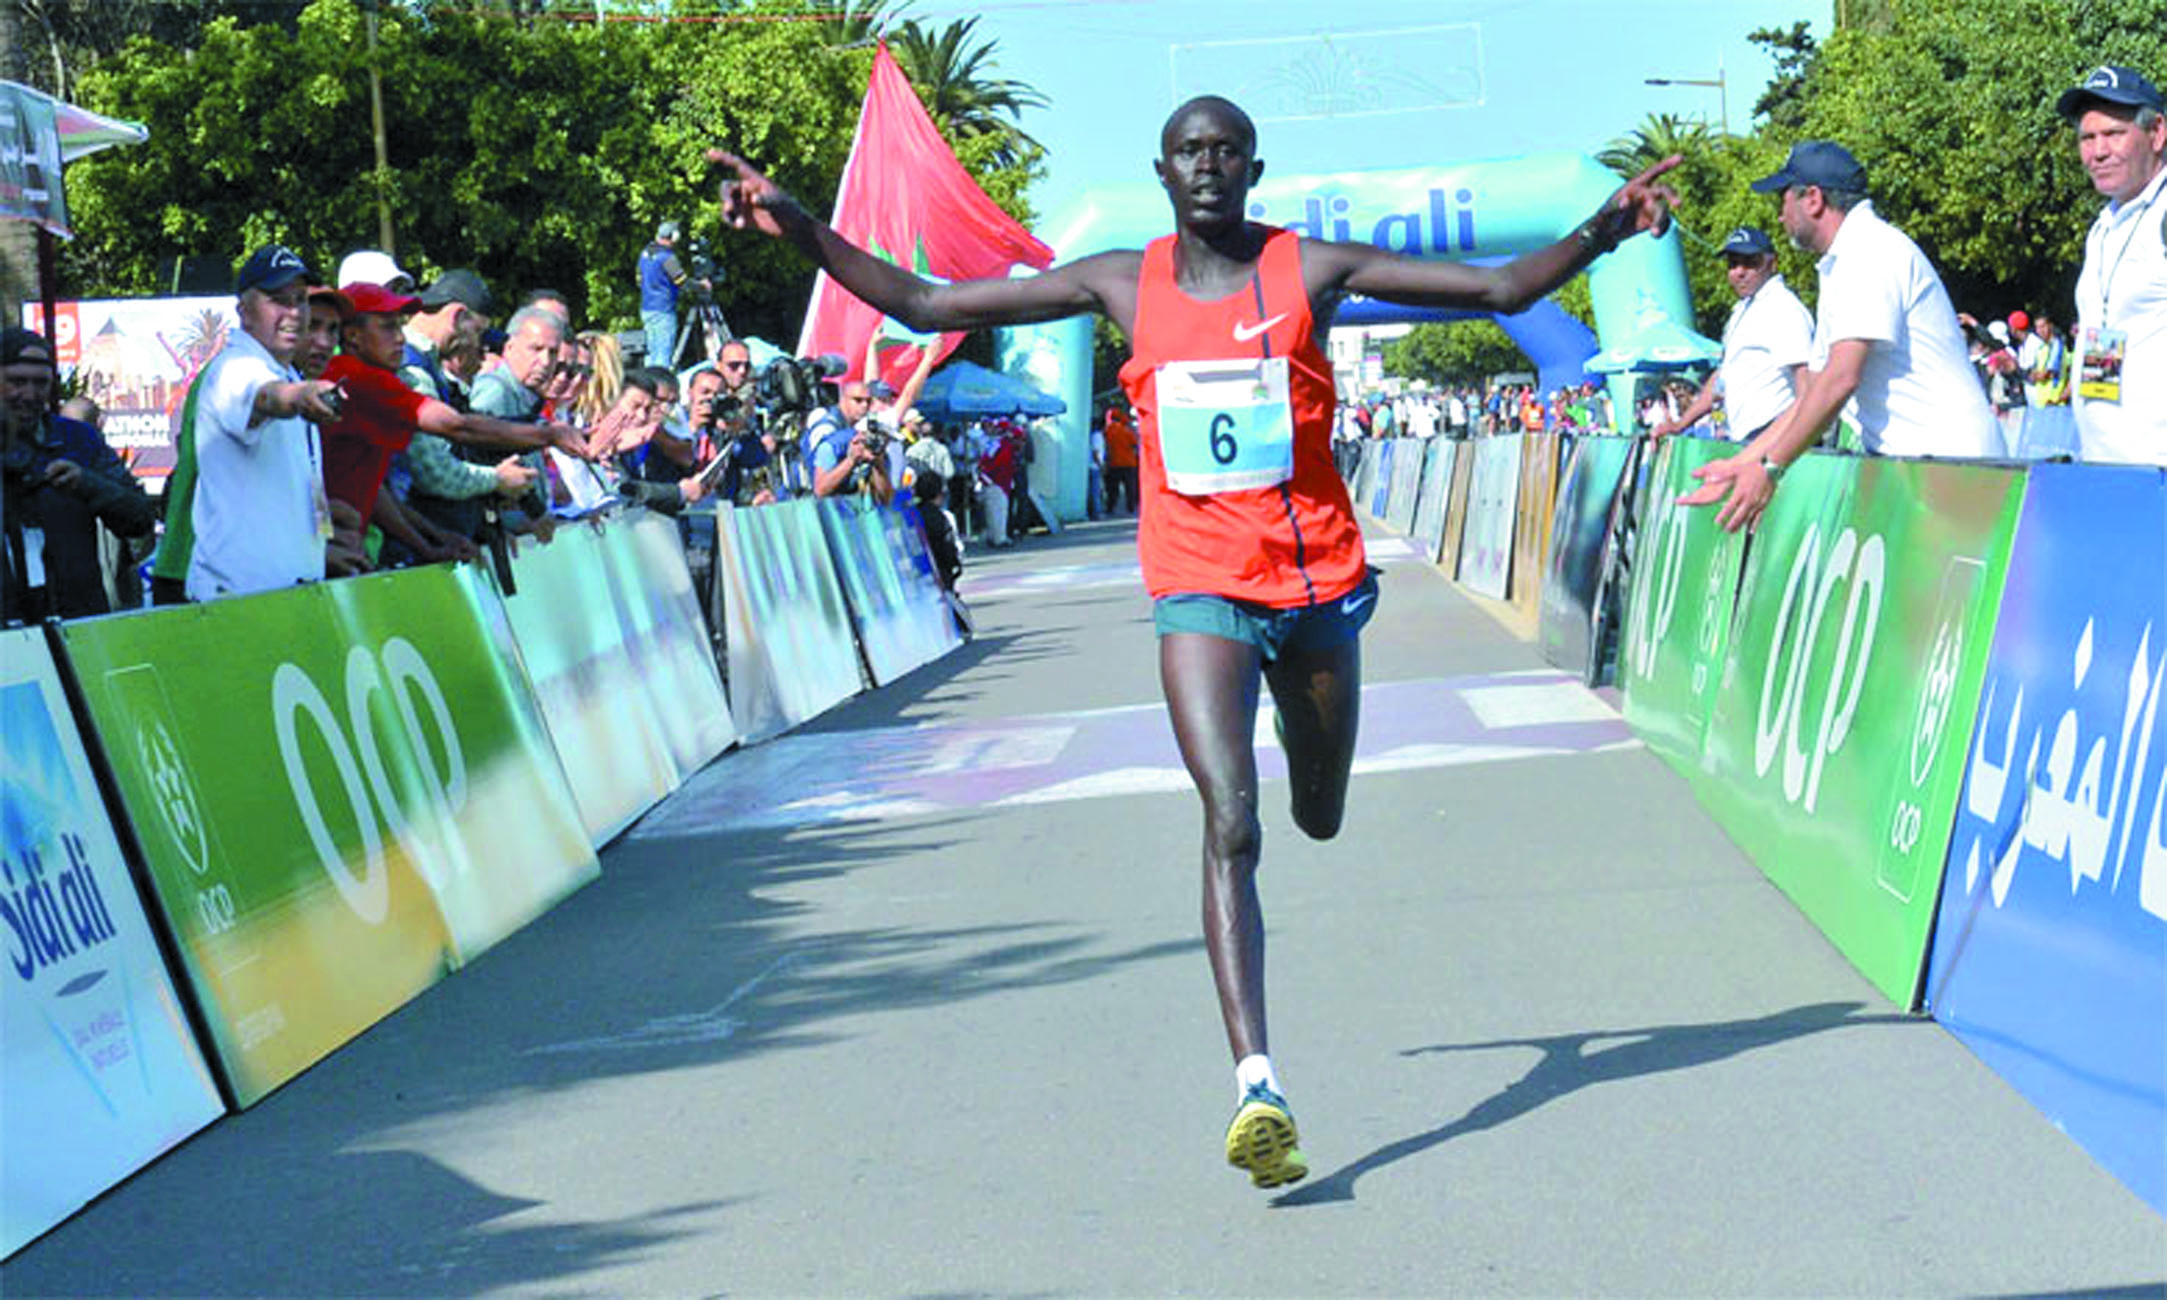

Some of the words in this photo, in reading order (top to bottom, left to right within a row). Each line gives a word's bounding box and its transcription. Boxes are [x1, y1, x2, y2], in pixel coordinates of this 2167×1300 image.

[1372, 188, 1476, 256] ali
[1210, 412, 1238, 465] 6
[1754, 522, 1885, 814] OCP
[271, 636, 468, 925] OCP
[1965, 615, 2167, 910] المغرب
[1890, 800, 1922, 855] OCP
[59, 832, 117, 949] ali
